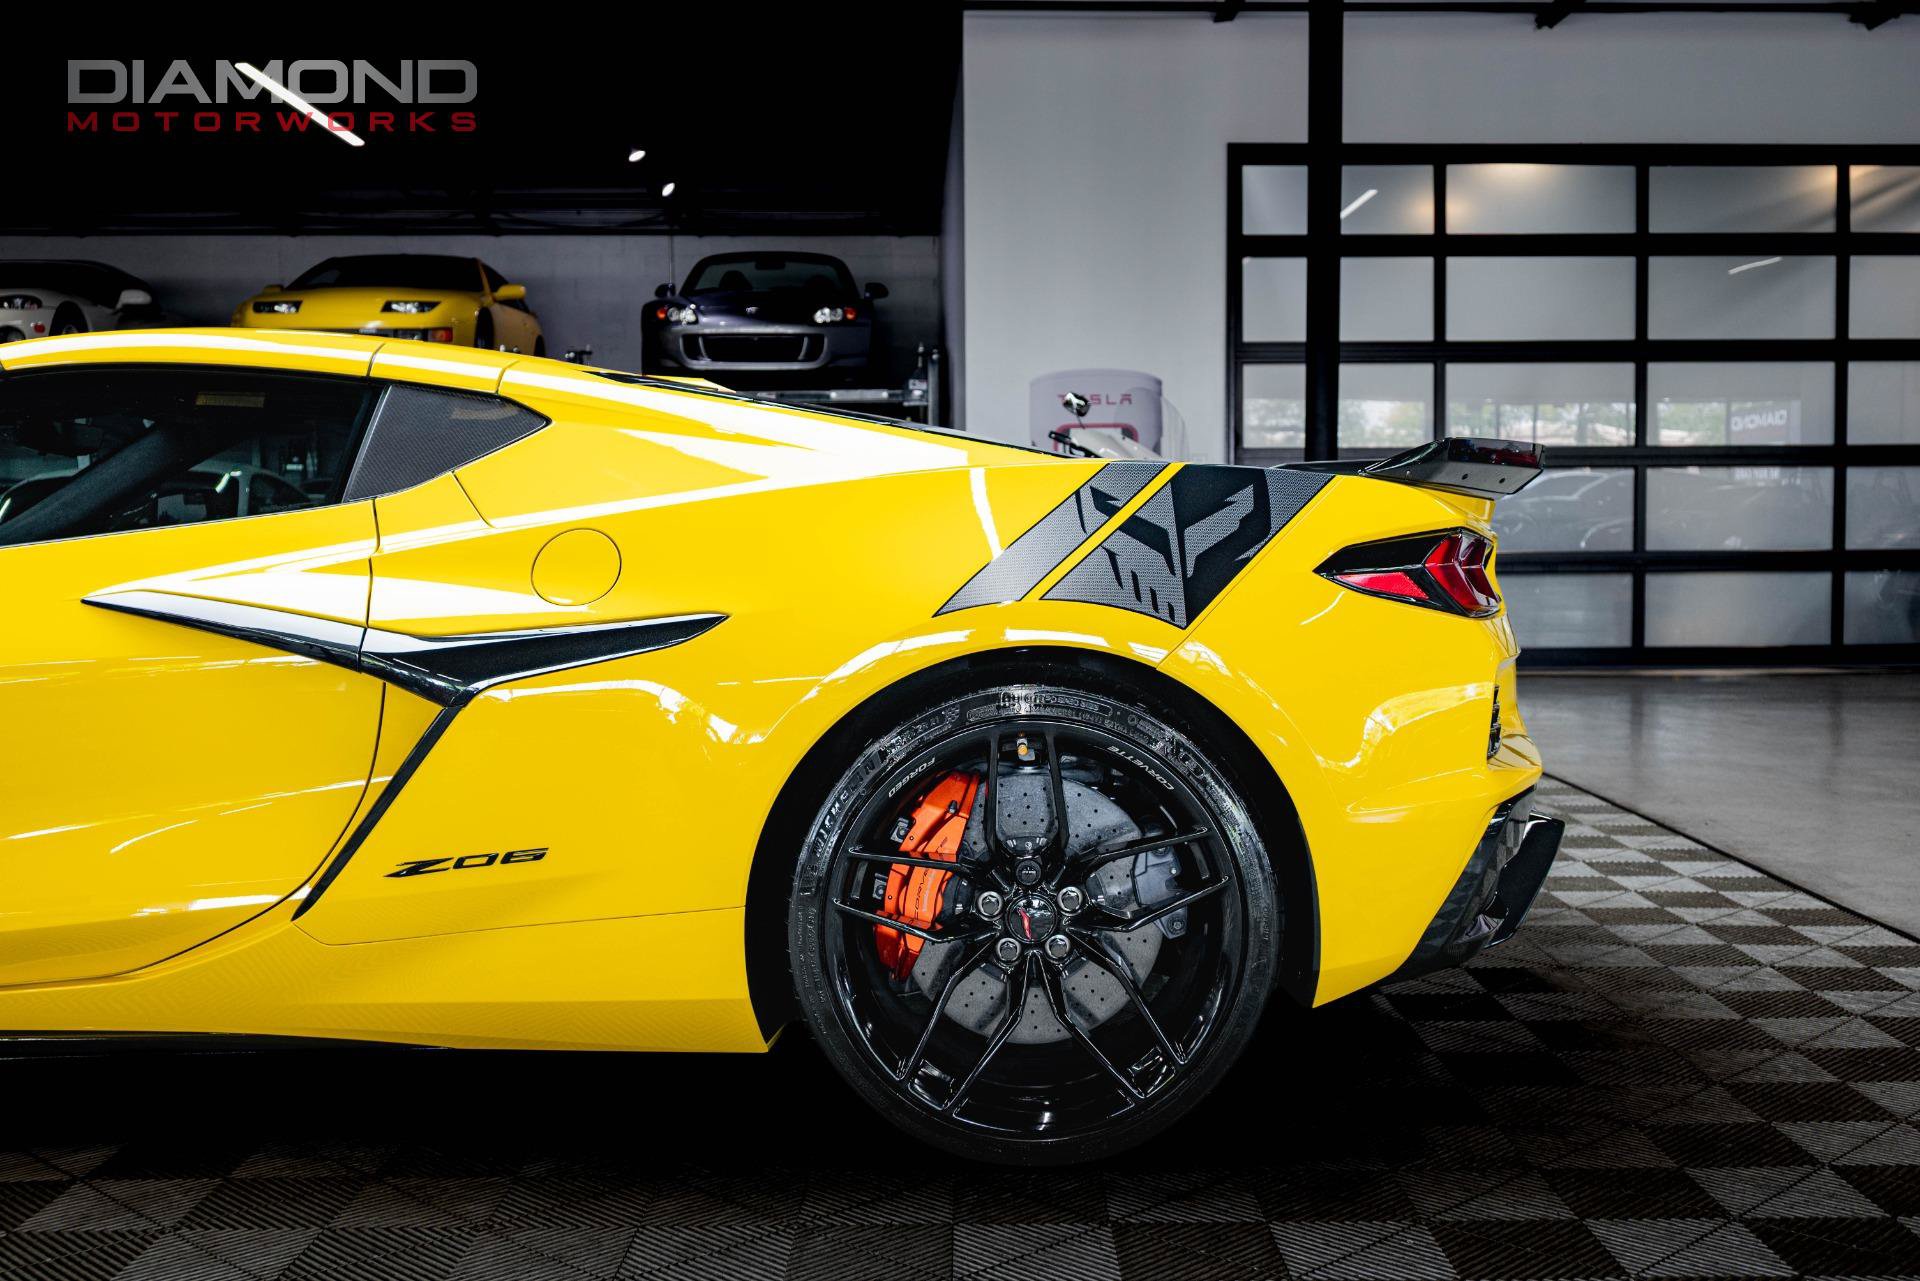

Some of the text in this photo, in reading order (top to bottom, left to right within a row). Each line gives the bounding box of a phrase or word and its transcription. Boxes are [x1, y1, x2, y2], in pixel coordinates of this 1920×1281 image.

[1057, 393, 1133, 405] TSLA
[888, 756, 936, 798] FORGED
[1106, 745, 1175, 790] CORVETTE
[383, 847, 550, 878] Z06
